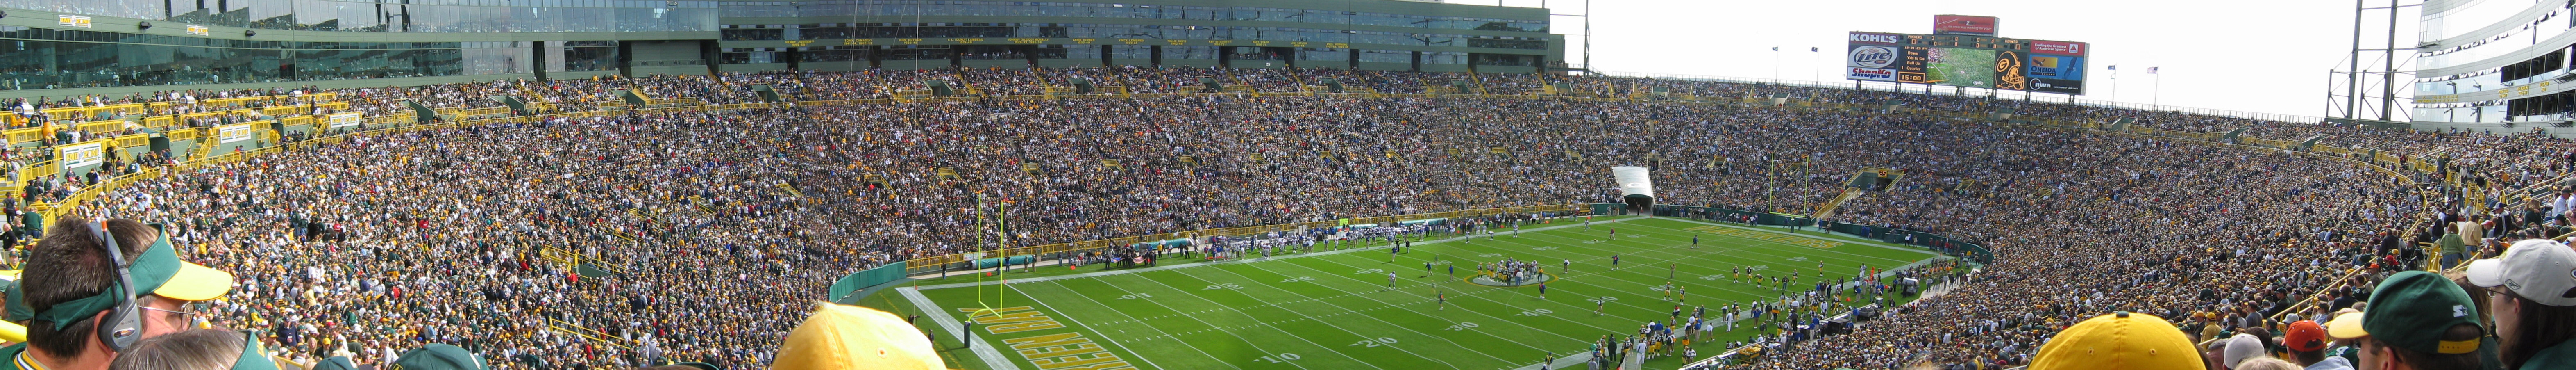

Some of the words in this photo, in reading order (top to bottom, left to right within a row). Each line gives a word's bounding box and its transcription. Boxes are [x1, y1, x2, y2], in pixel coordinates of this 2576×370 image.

[1850, 34, 1897, 43] KOHL'S
[1857, 52, 1892, 63] Lite
[1852, 68, 1891, 79] ShopKo
[66, 152, 79, 162] END
[1683, 225, 1844, 249] PACKERS
